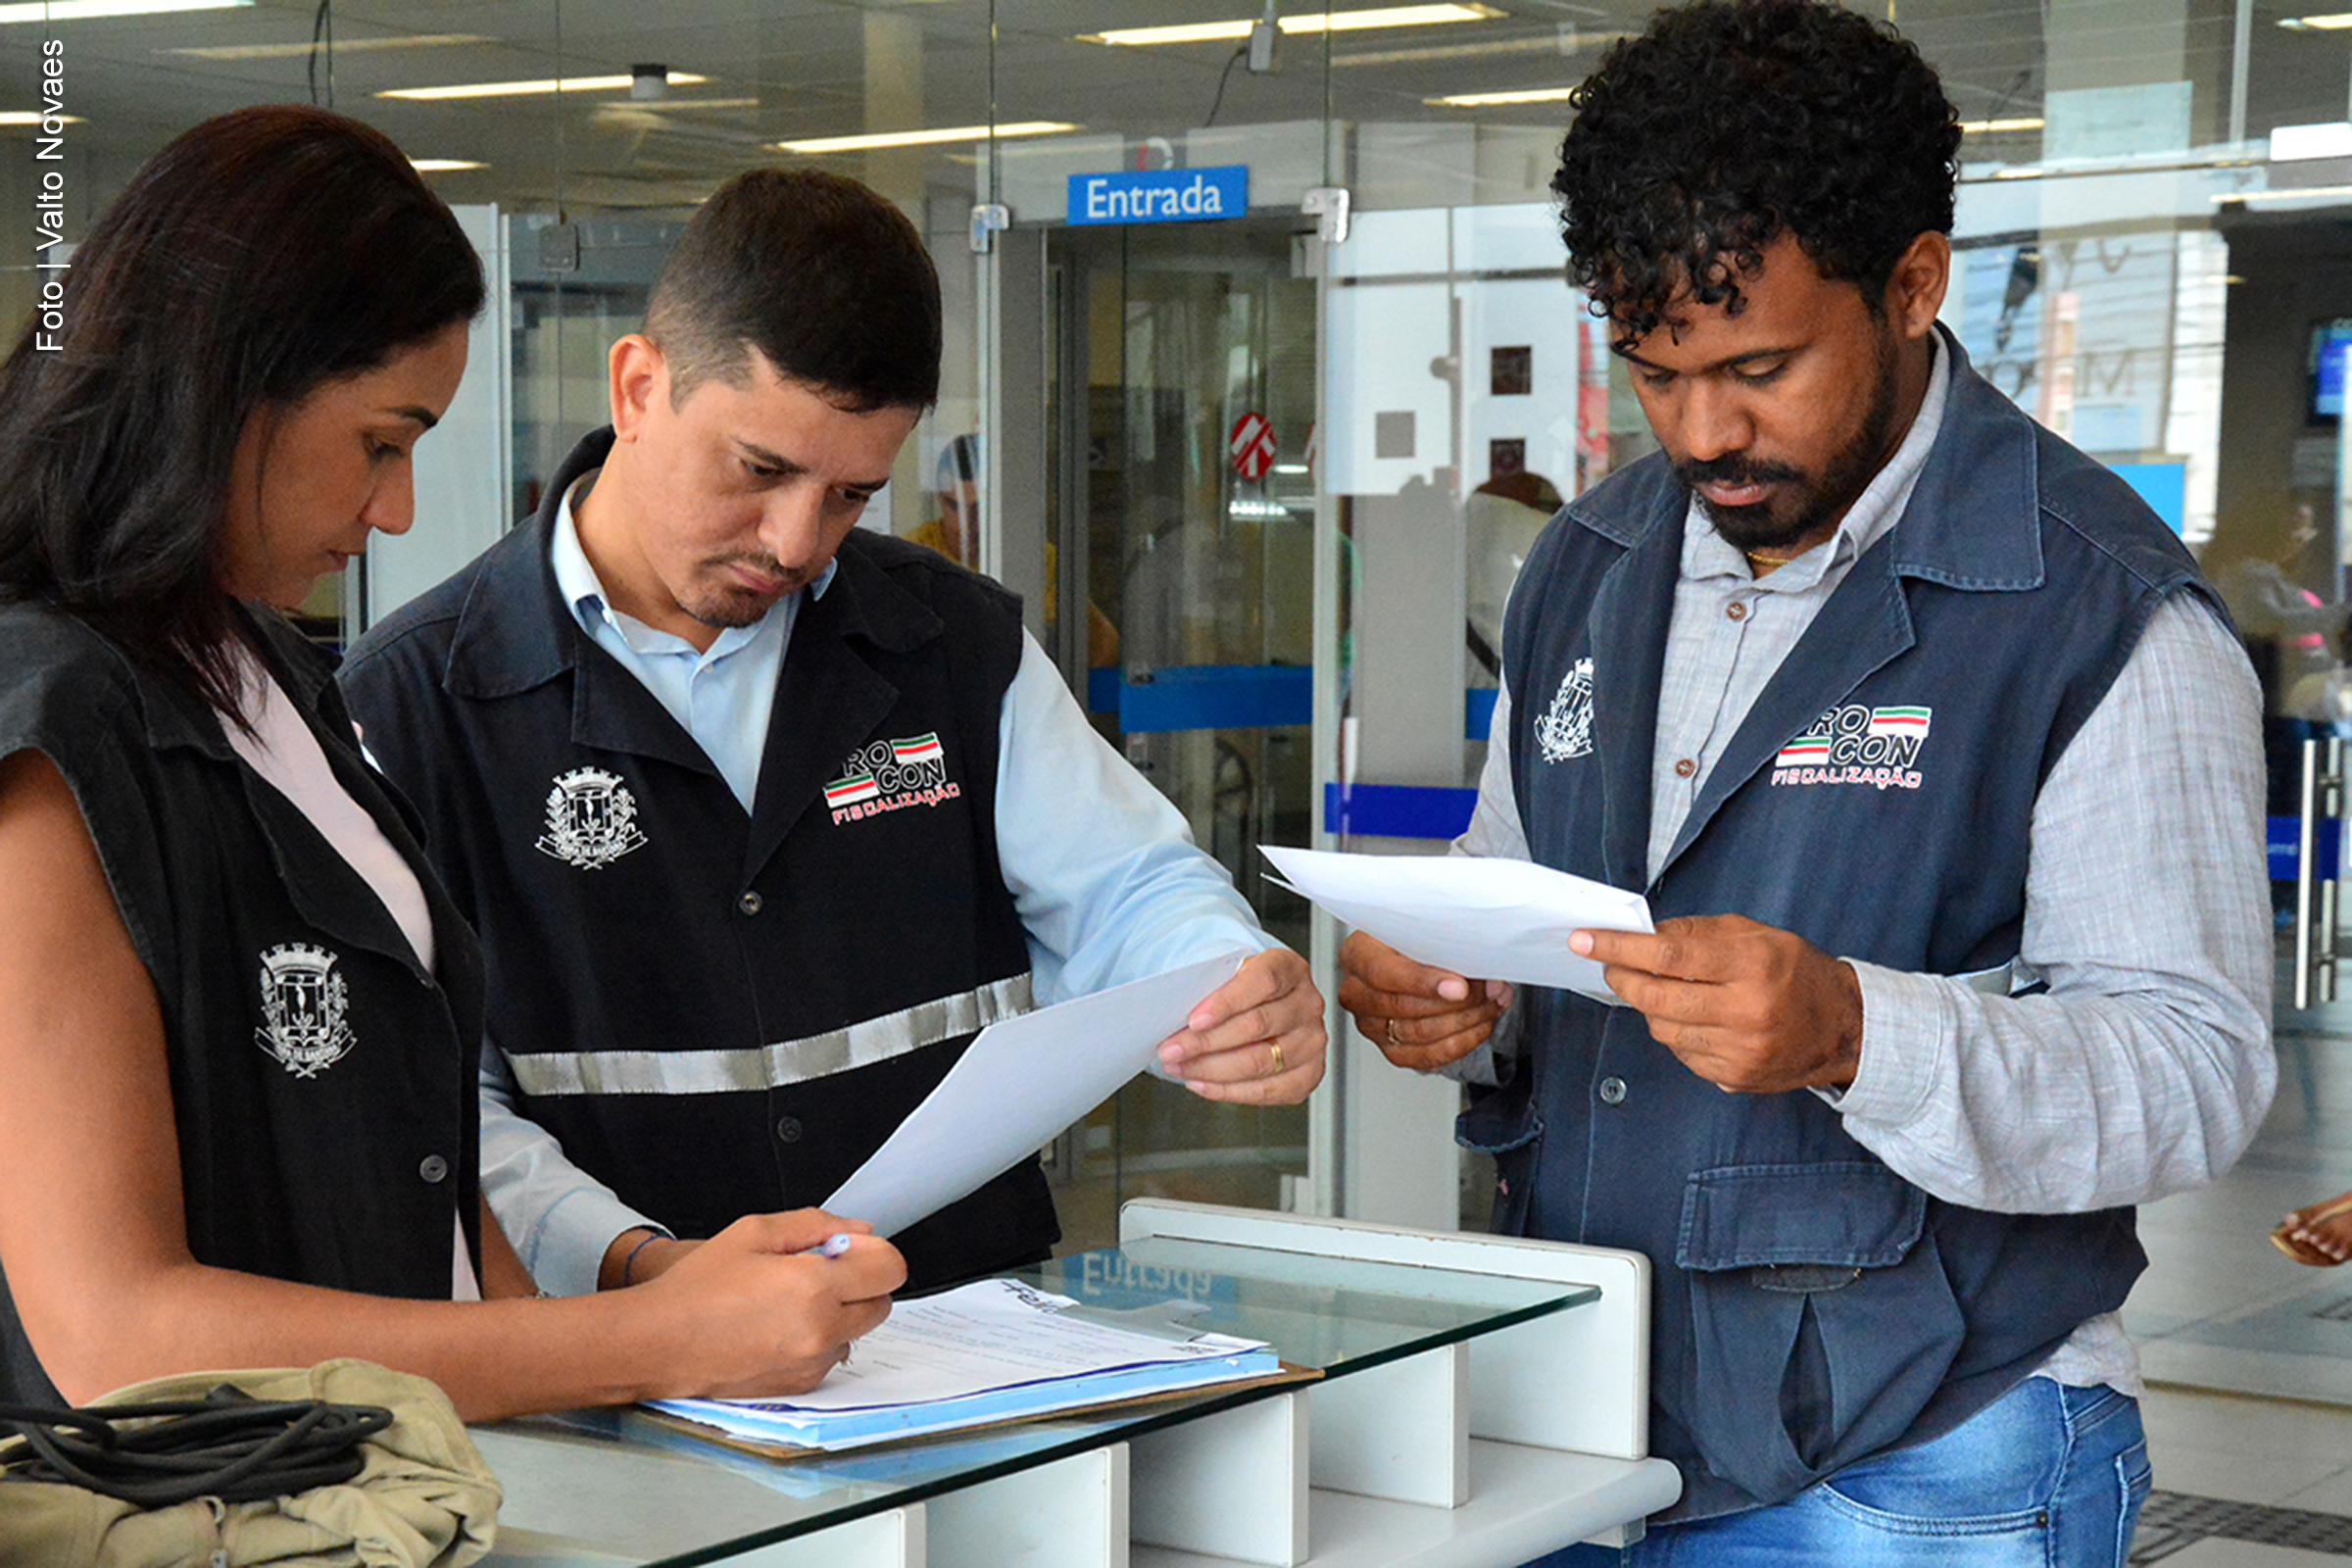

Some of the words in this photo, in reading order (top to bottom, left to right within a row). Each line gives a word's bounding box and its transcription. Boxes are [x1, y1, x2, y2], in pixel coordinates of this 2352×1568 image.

[1087, 172, 1224, 220] Entrada
[1806, 704, 1871, 736] RO
[842, 739, 893, 778] RO
[1830, 734, 1925, 769] CON
[875, 755, 948, 795] CON
